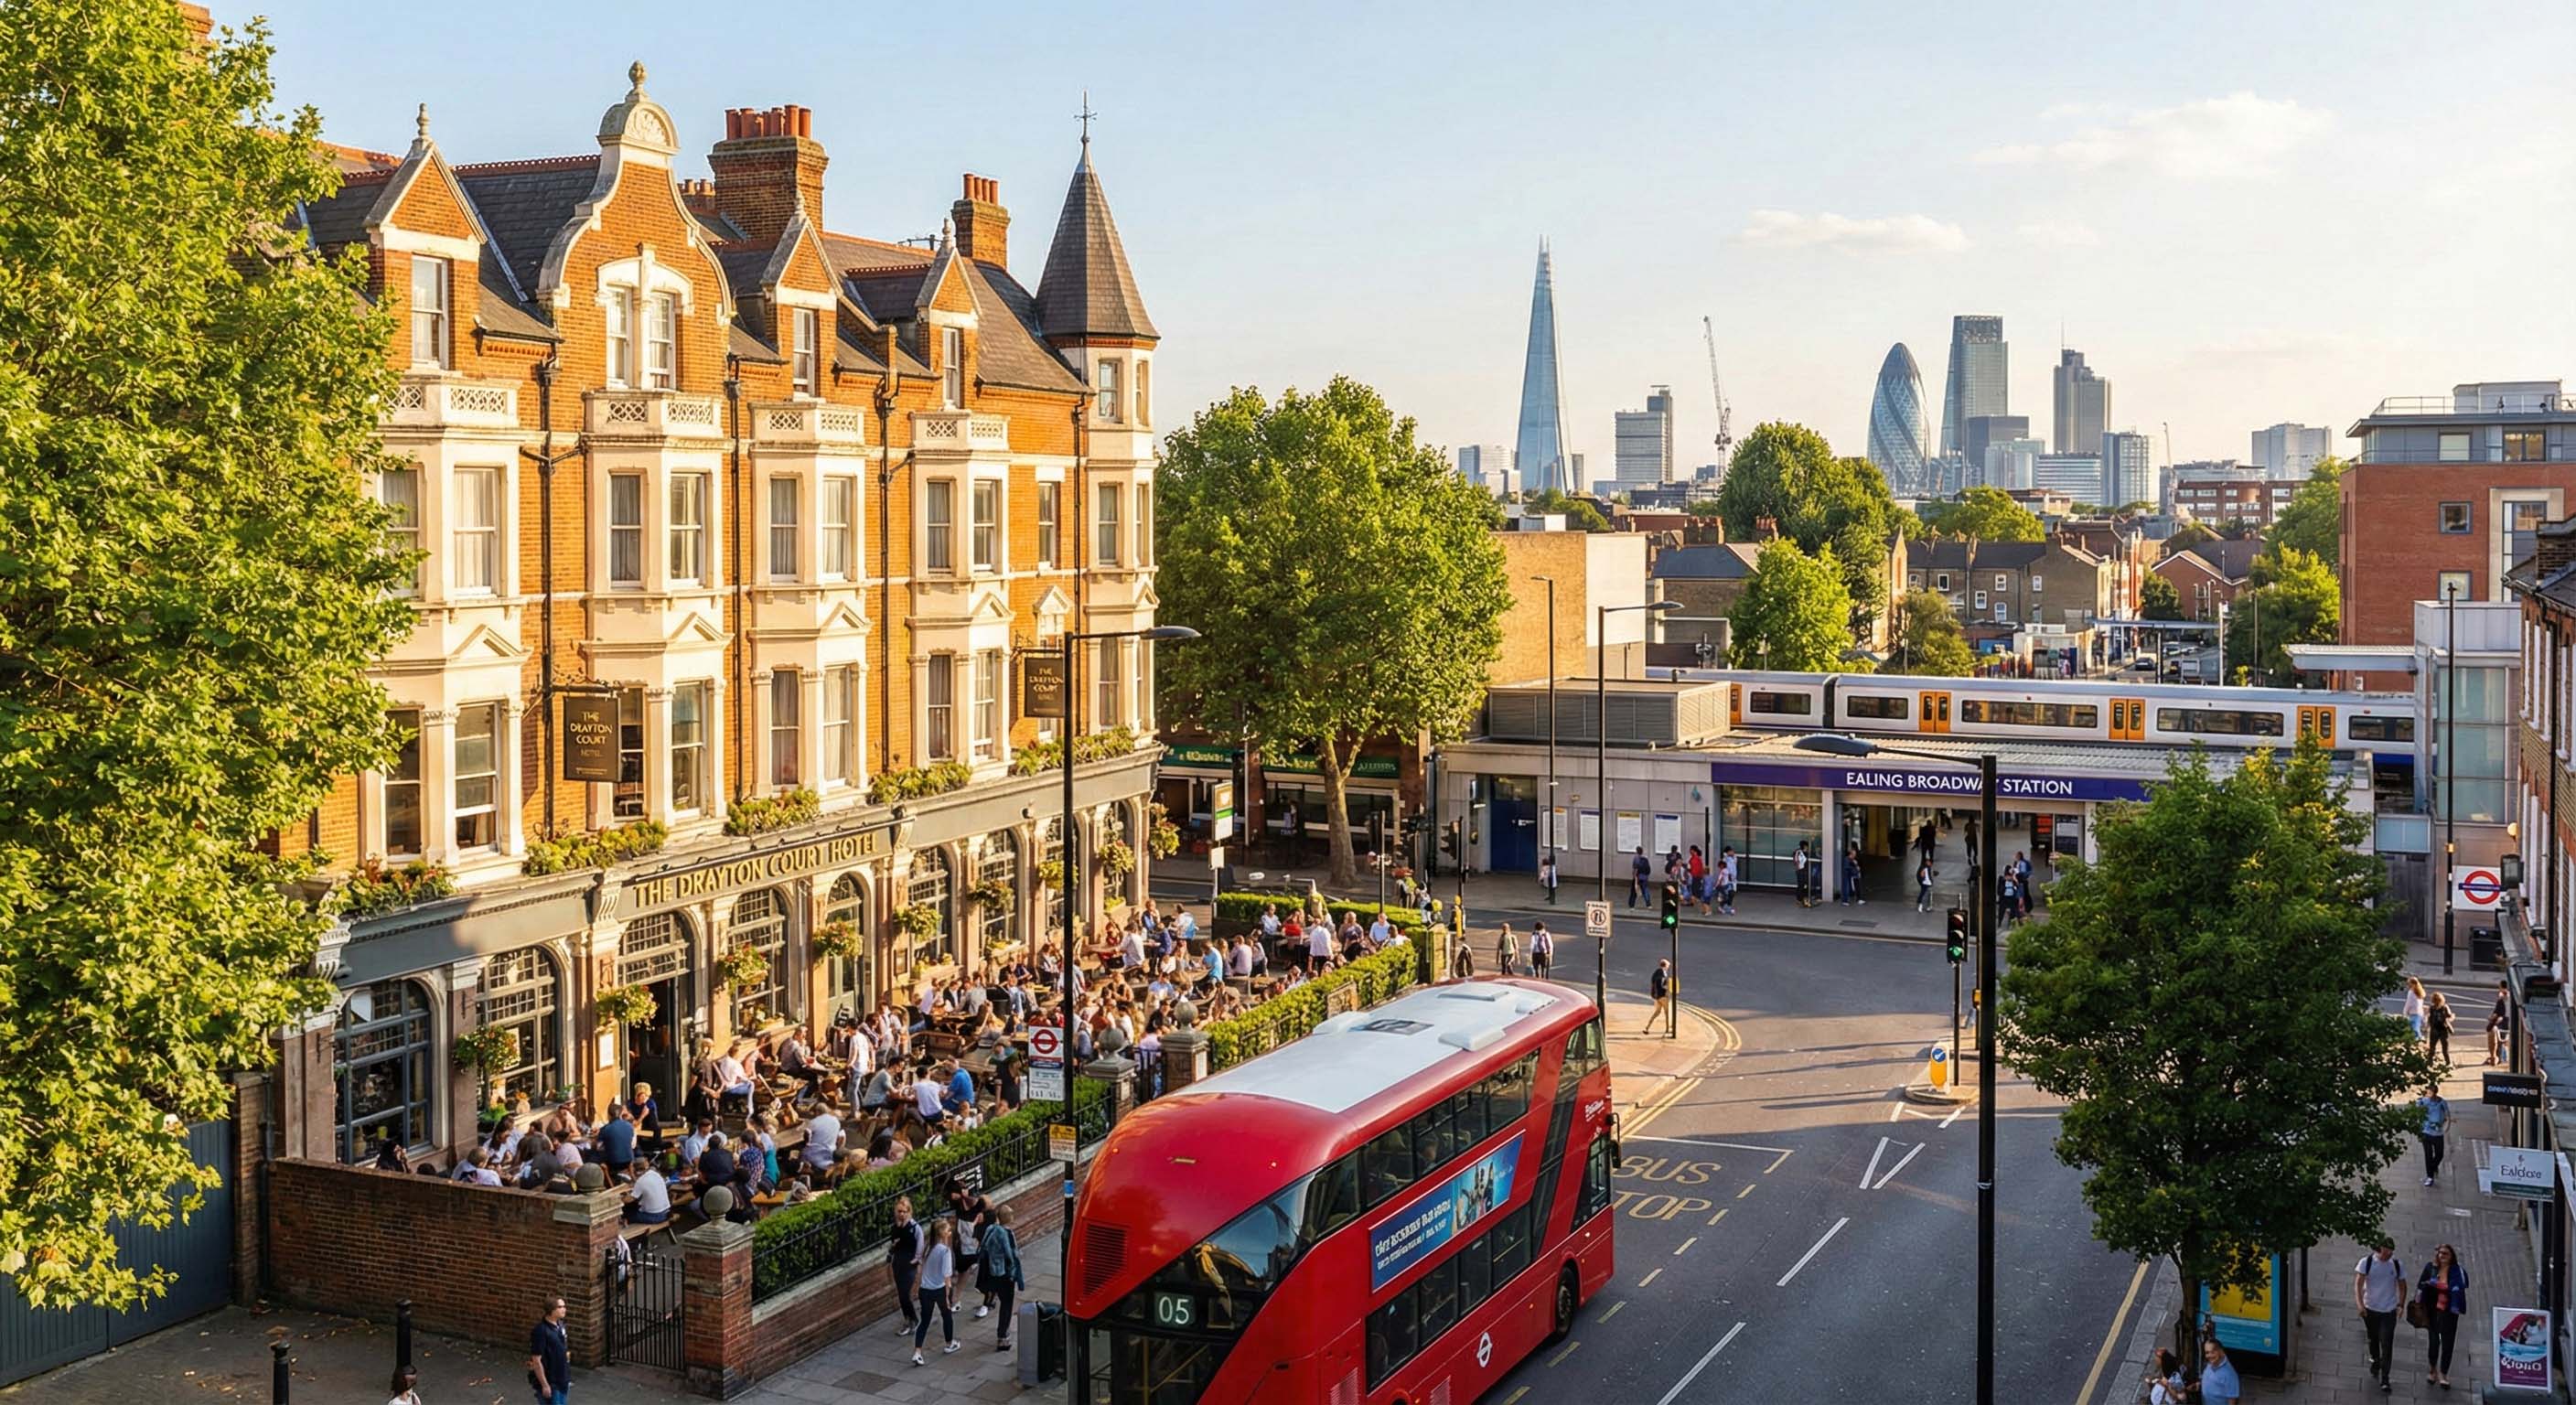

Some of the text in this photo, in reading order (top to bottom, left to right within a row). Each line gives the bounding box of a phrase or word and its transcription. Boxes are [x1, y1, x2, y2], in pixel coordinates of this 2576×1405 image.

[570, 723, 613, 734] DRAYTON
[581, 711, 600, 722] THE
[576, 734, 606, 745] COURT
[1846, 772, 2073, 795] EALING BROADW STATION
[634, 833, 878, 908] THE DRAYTON COURT HOTEL
[1610, 1155, 1722, 1185] BUS
[1613, 1190, 1712, 1220] TOP
[1159, 1295, 1190, 1325] 05
